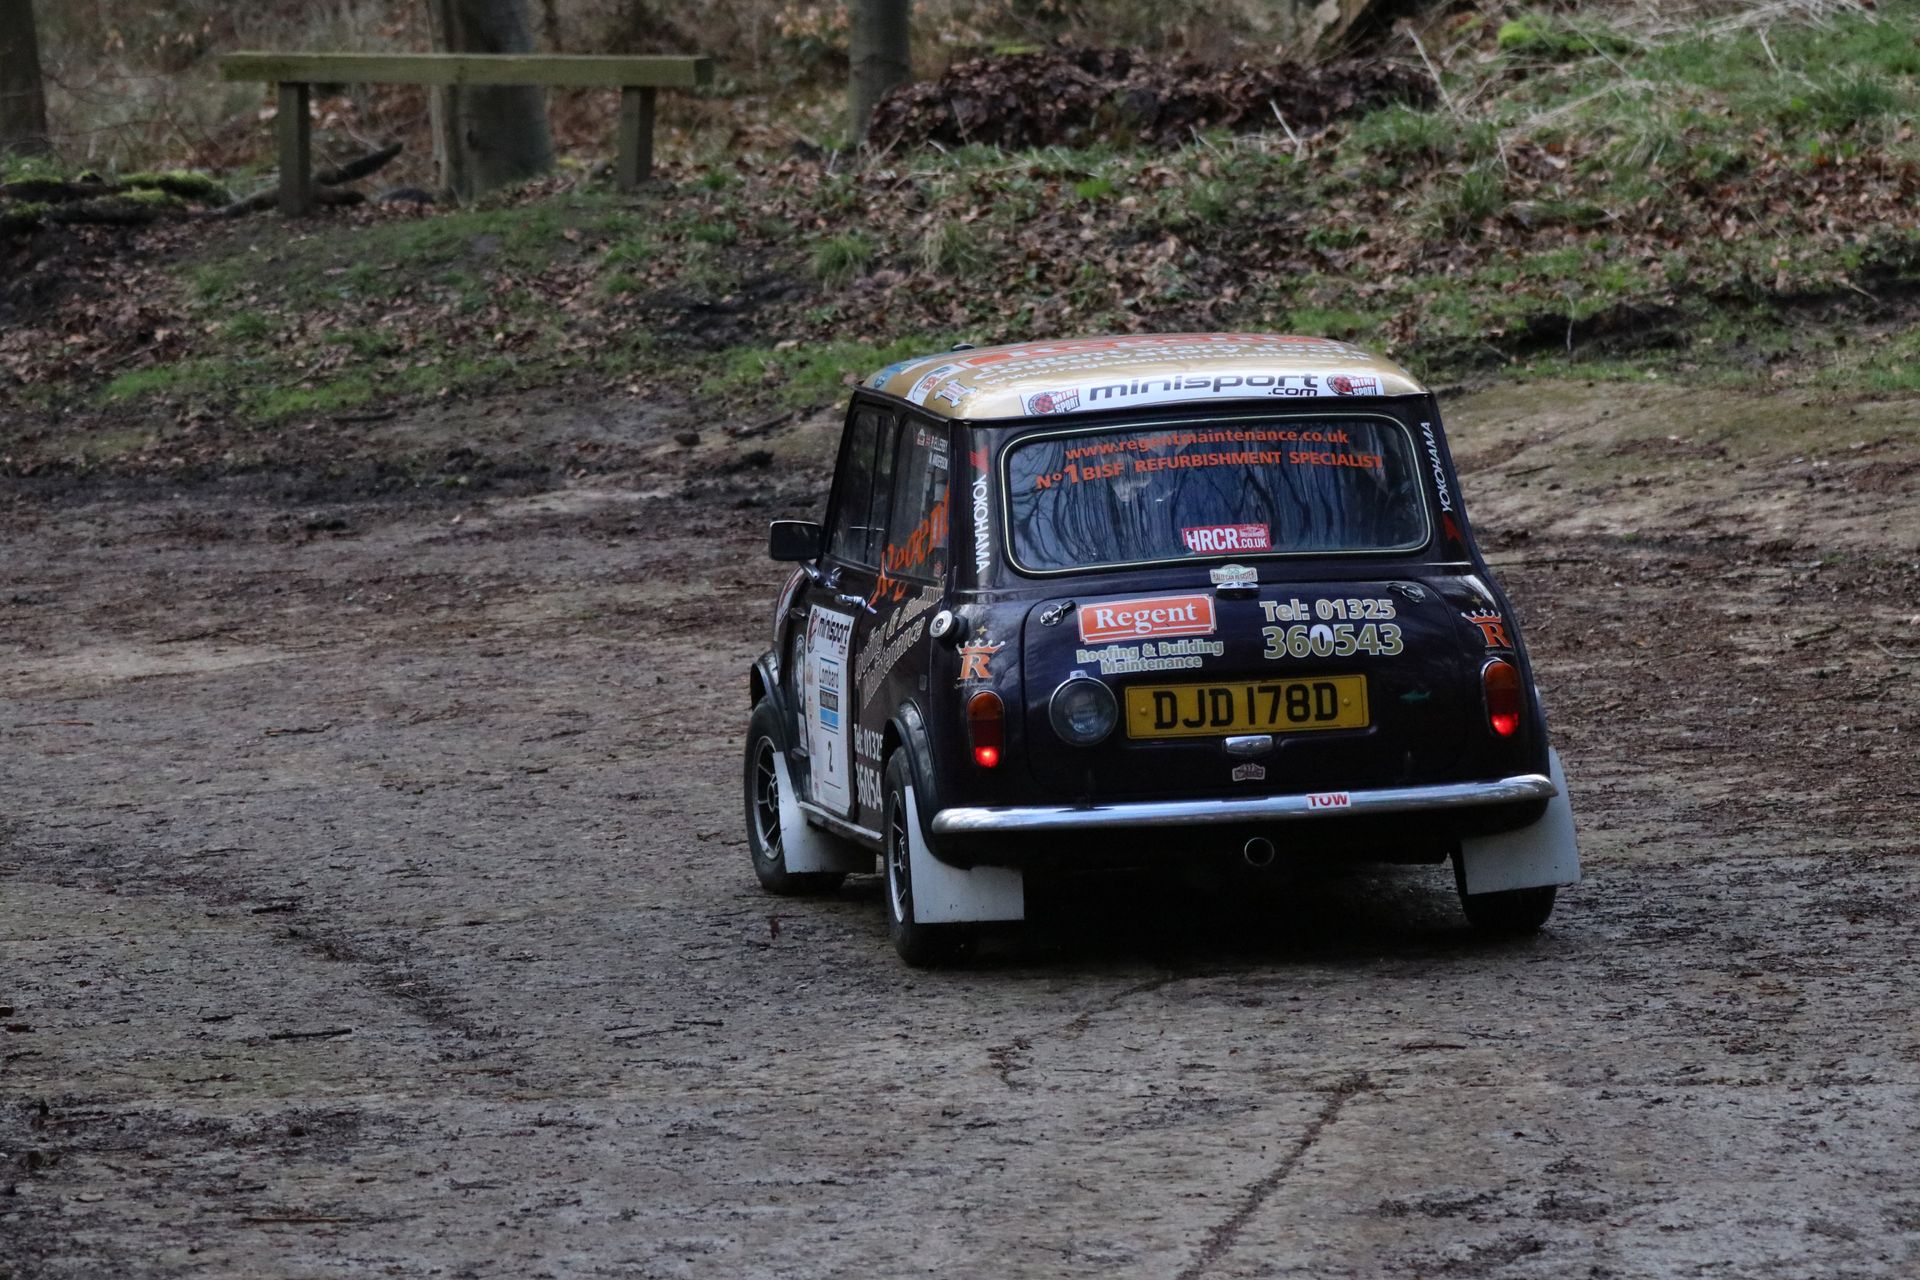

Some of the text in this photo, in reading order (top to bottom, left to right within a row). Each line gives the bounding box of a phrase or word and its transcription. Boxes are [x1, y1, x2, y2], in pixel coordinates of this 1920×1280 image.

[1089, 374, 1319, 401] minisport
[1268, 387, 1317, 397] .com
[1351, 375, 1377, 387] MINI
[1352, 387, 1377, 396] SPORT
[1051, 388, 1080, 403] MINI
[1054, 397, 1081, 415] SPORT
[1065, 428, 1349, 460] www.regentmaintenance.co.uk
[1082, 462, 1125, 481] BISF
[1135, 451, 1282, 473] REFURBISHMENT
[1289, 451, 1383, 469] SPECIALIST
[1420, 421, 1453, 512] YOKOHAMA
[972, 474, 991, 574] YOKOHAMA
[1186, 528, 1268, 552] HRCR .CO.UK
[1095, 602, 1199, 634] Regent
[1259, 599, 1397, 622] Tel: 01325
[816, 613, 852, 648] minisport
[1262, 623, 1404, 660] 360543
[1076, 639, 1225, 664] Roofing & Building
[1100, 655, 1203, 675] Maintenance
[1152, 681, 1339, 730] DJD 178D
[1308, 793, 1348, 807] TOW
